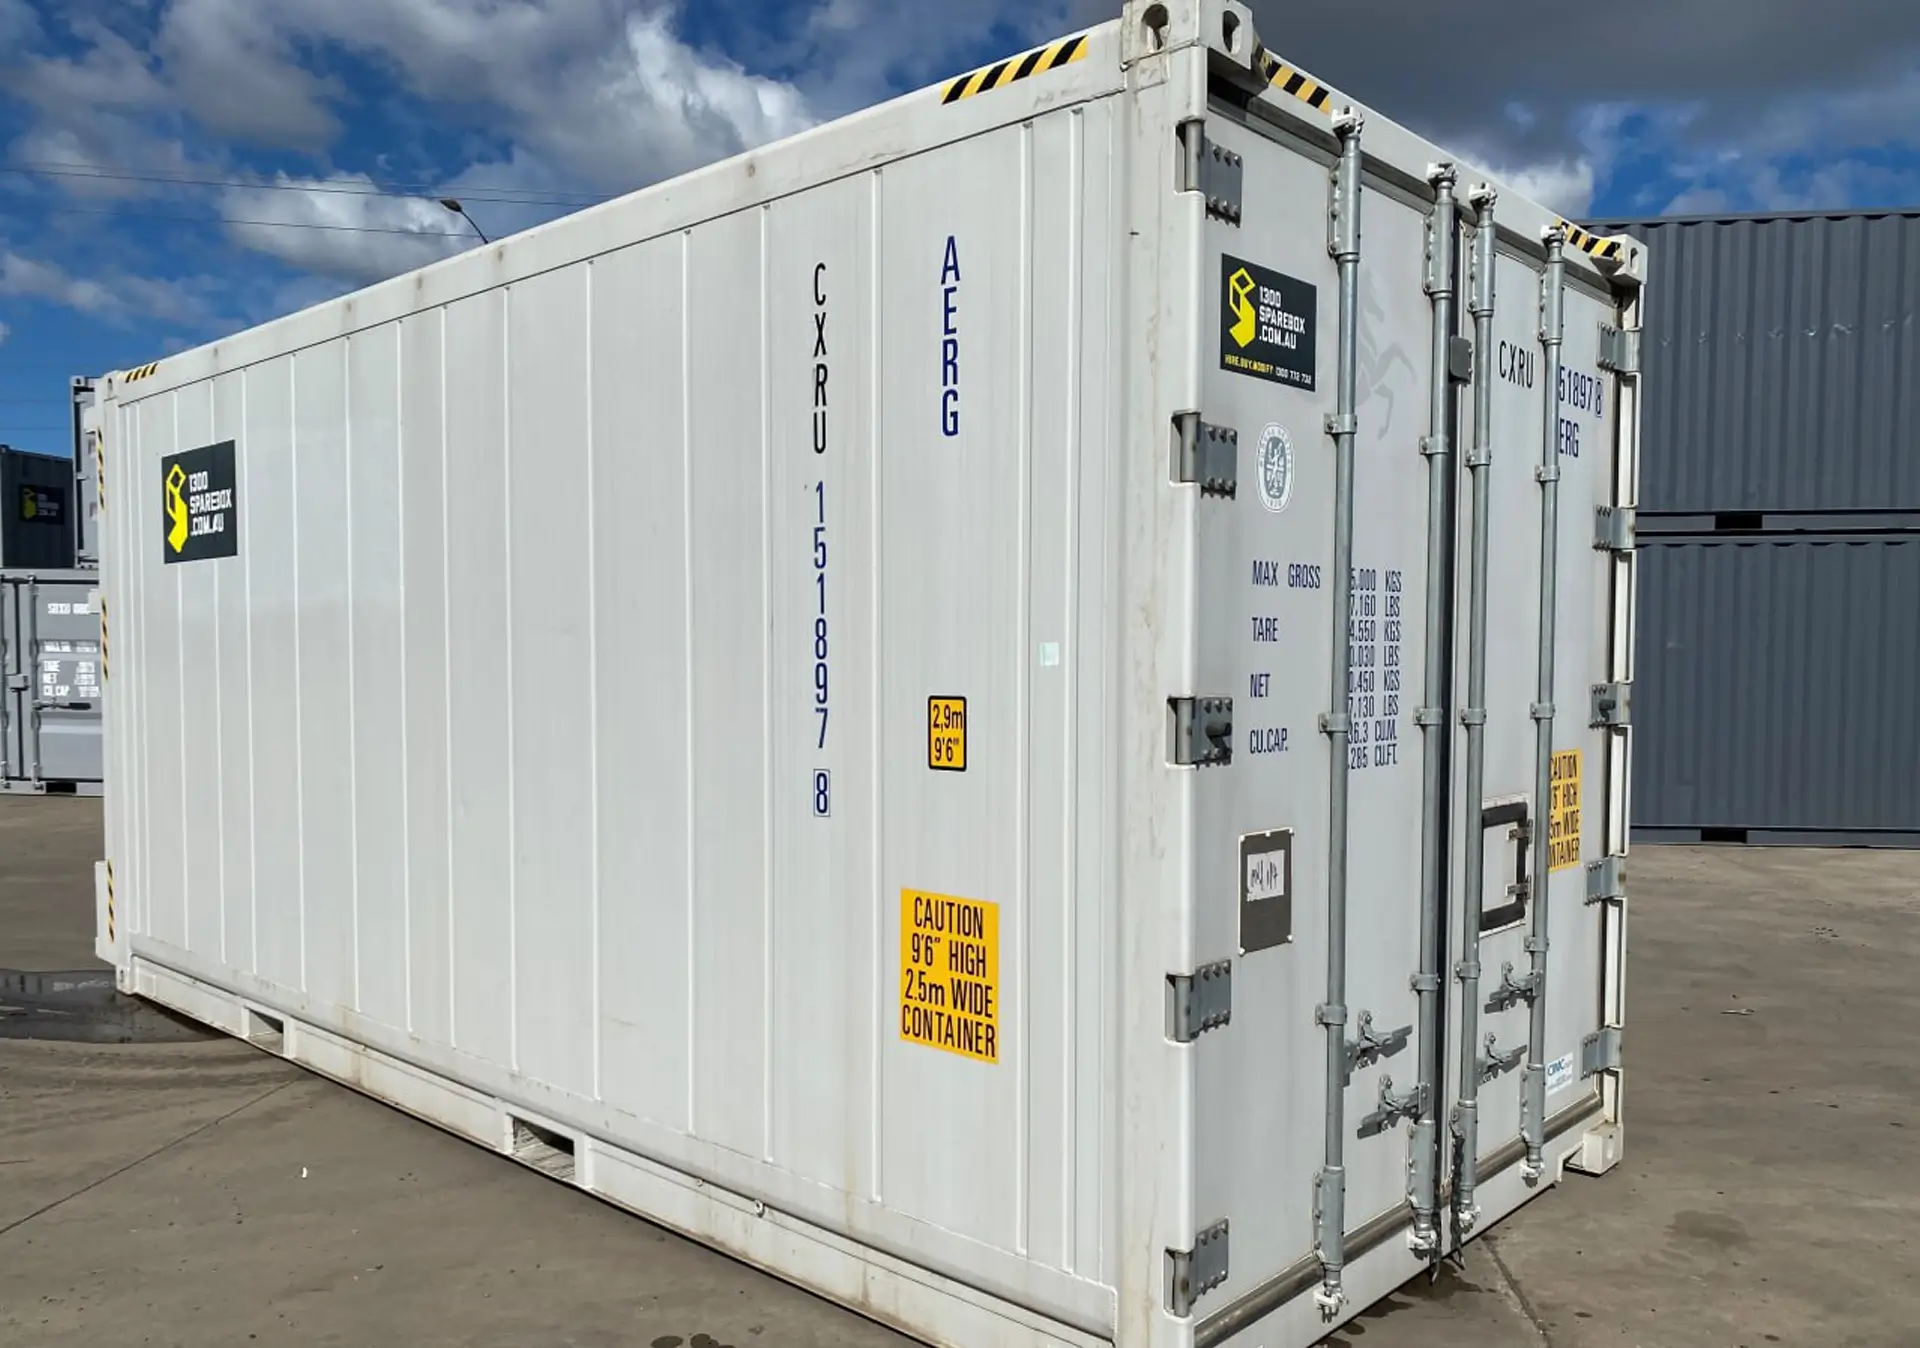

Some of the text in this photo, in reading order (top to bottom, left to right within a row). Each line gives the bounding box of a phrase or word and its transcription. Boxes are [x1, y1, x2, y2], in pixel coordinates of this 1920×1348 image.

[1258, 286, 1282, 308] 1300
[1258, 305, 1306, 334] SPAREBOX
[941, 235, 960, 437] AERG
[1258, 325, 1297, 349] .COM.AU
[1499, 340, 1602, 416] CXRU 51897 8
[1559, 417, 1579, 458] ERG
[189, 471, 208, 493] 1300
[189, 488, 232, 514] SPAREBOX
[190, 513, 225, 536] .COM.AU
[813, 262, 828, 815] CXRU 151897 8
[1252, 560, 1402, 592] MAX GROSS 5.000 KGS
[1350, 594, 1400, 617] 7.160 LBS
[1252, 617, 1278, 642] TARE
[1384, 620, 1401, 642] KGS
[1349, 645, 1400, 667] 0.030 LBS
[1250, 670, 1400, 698] NET 0.450 KGS
[933, 704, 963, 733] 2,9m
[1348, 695, 1399, 718] 7.130 LBS
[934, 737, 959, 762] 9'6"
[1250, 728, 1288, 754] CU.CAP.
[914, 896, 984, 940] CAUTION
[911, 932, 986, 978] 9'6" HIGH
[904, 968, 993, 1019] 2.5m WIDE
[902, 1004, 996, 1058] CONTAINER
